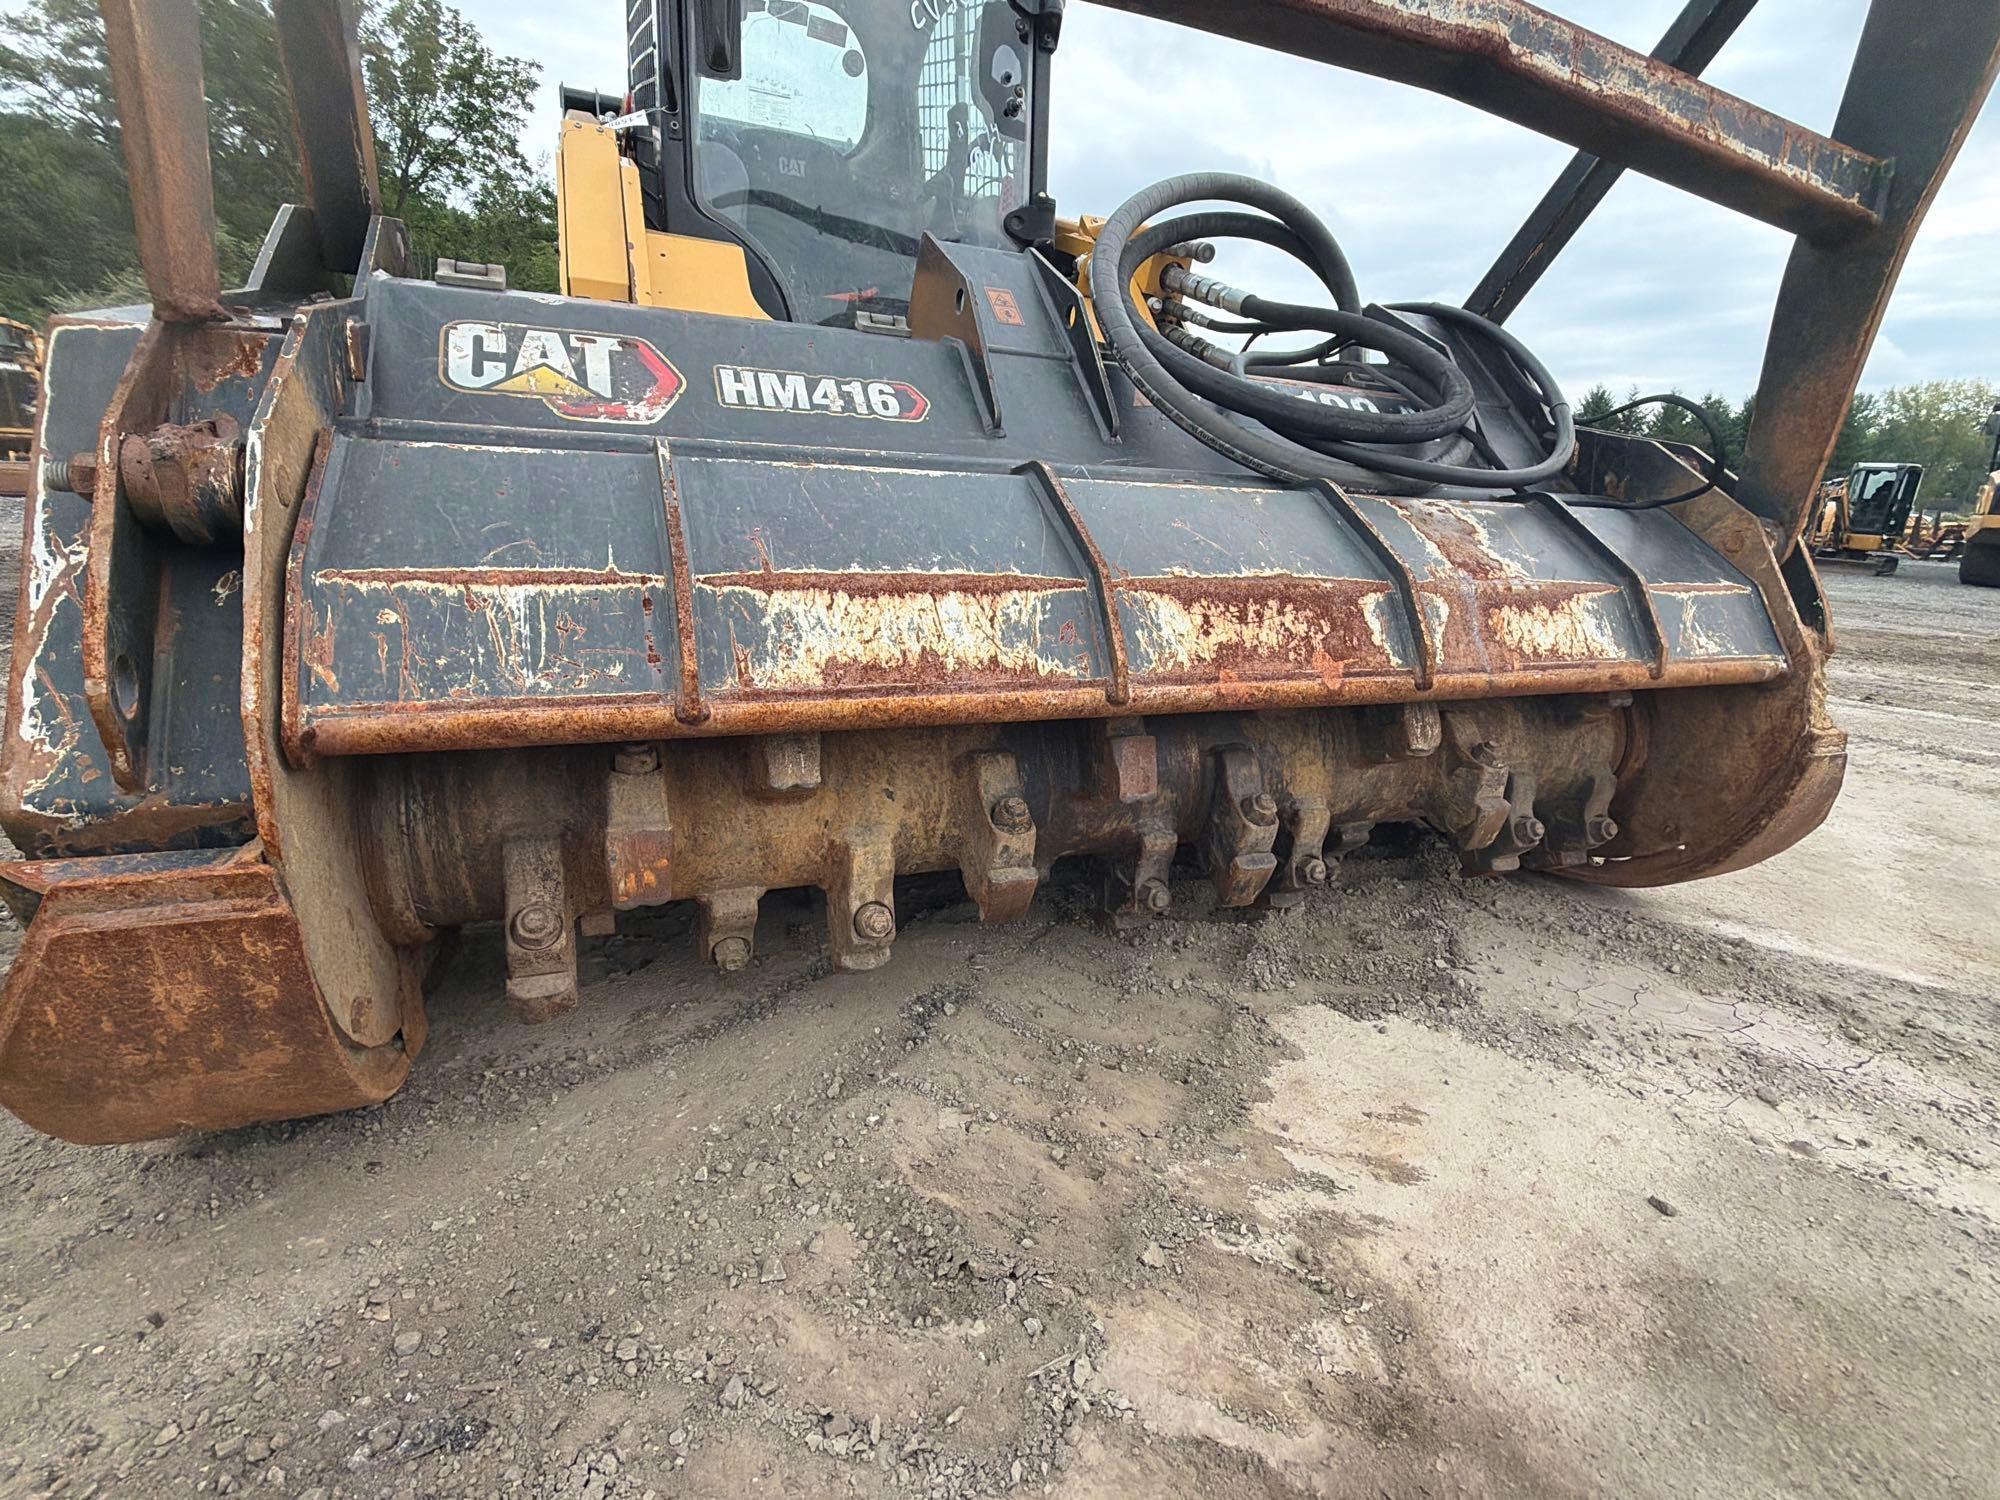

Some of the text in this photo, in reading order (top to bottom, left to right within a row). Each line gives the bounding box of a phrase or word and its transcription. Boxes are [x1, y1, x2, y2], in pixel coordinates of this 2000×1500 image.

[779, 157, 806, 177] CAT
[448, 323, 623, 399] CAT
[719, 368, 901, 417] HM416
